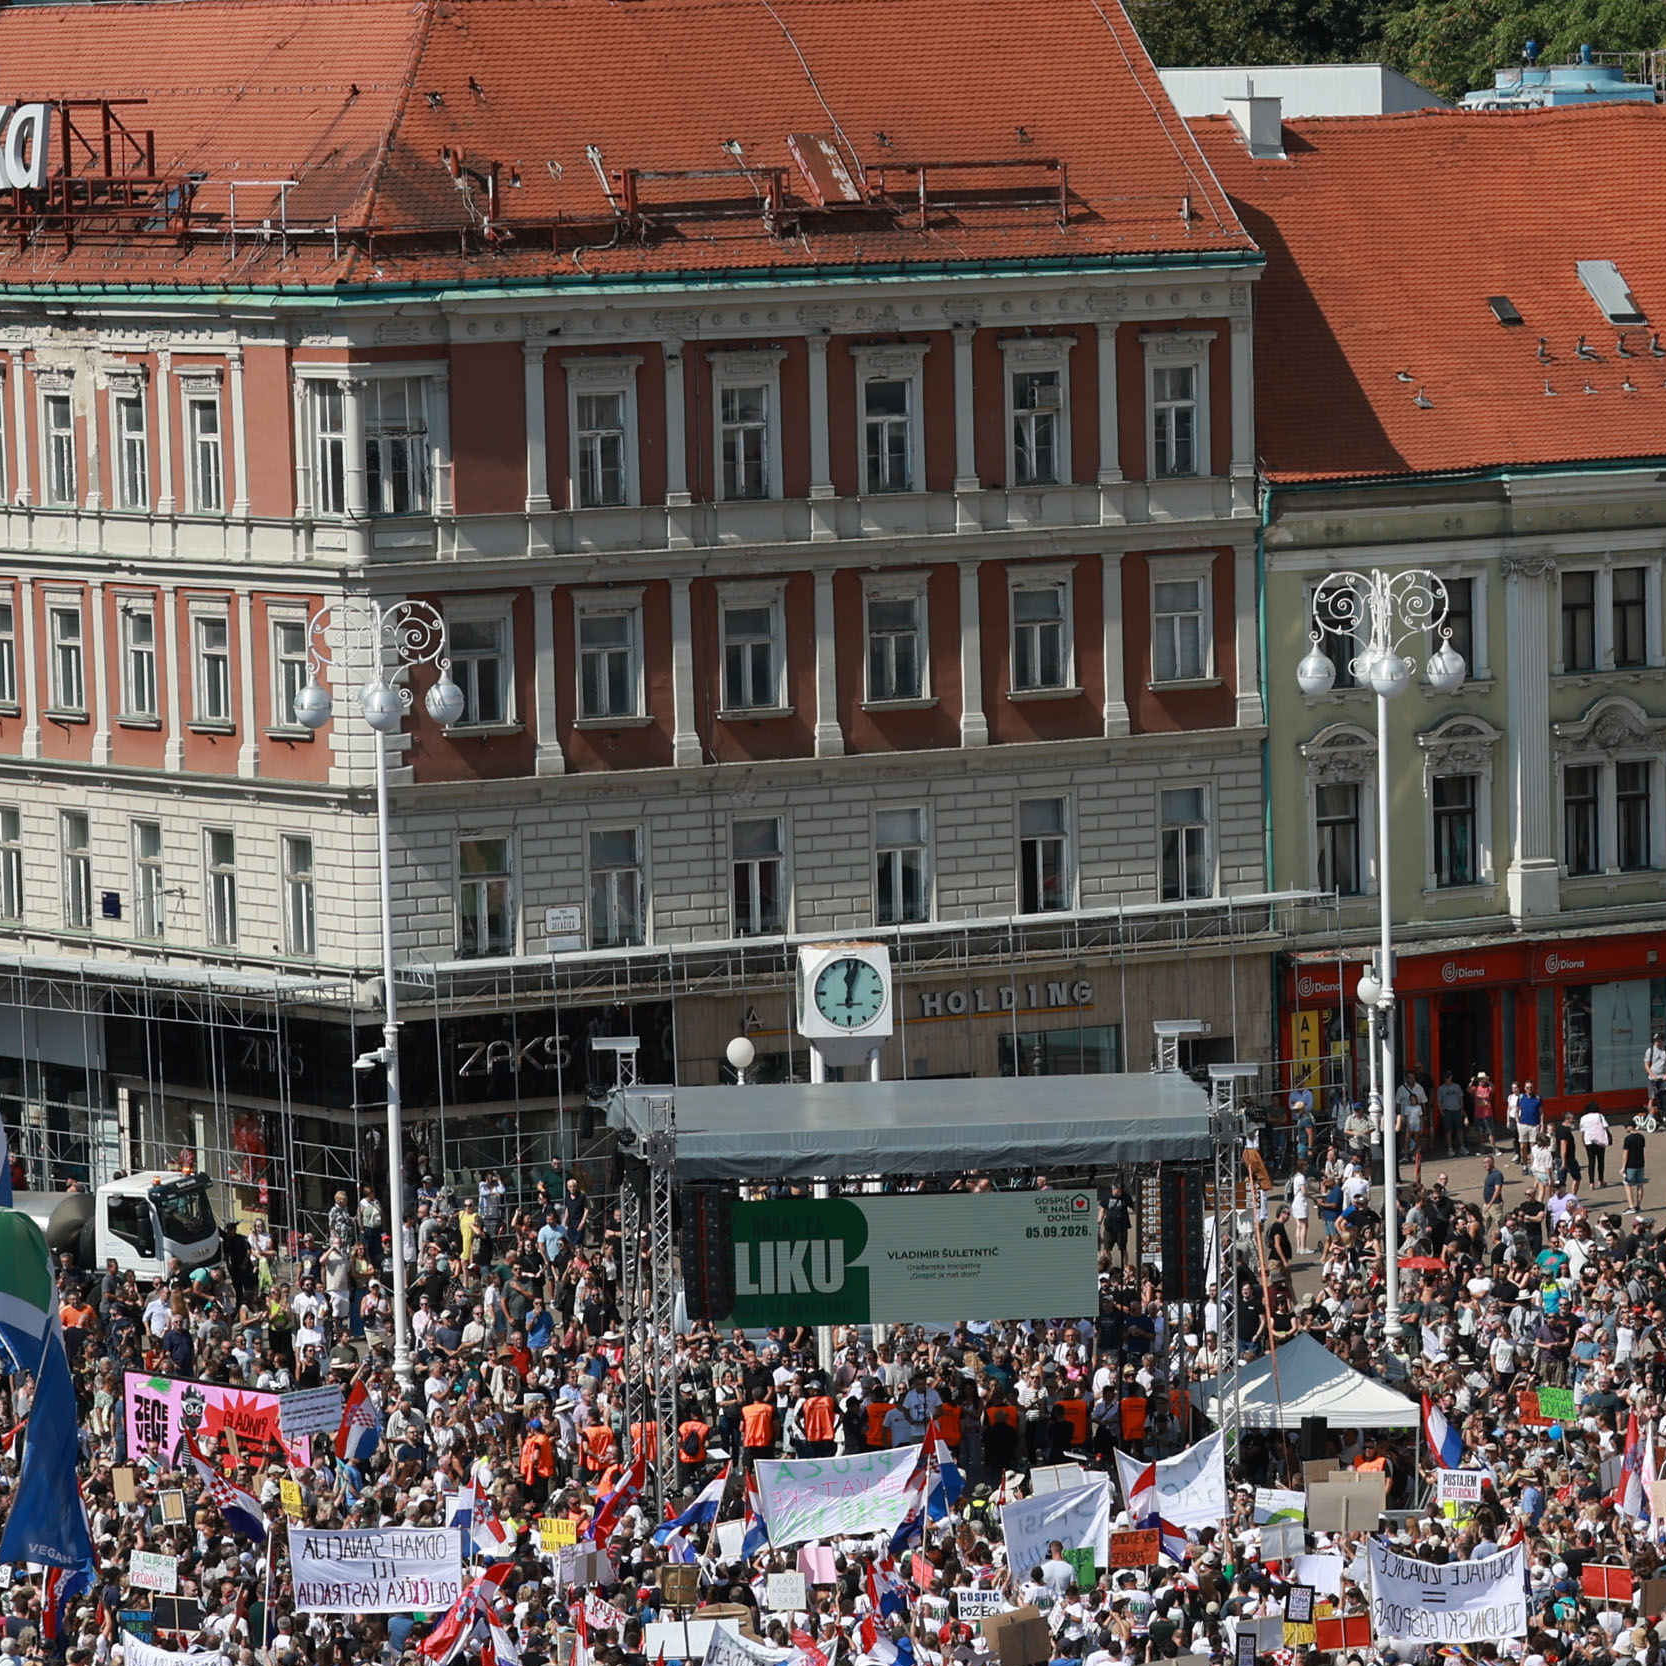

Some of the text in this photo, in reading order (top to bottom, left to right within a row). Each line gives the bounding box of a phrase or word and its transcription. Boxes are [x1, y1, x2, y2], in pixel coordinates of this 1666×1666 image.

[1560, 957, 1585, 971] Diona
[1458, 965, 1486, 979] Diona
[921, 979, 1094, 1017] HOLDING
[457, 1035, 571, 1078] ZAKS
[1034, 1195, 1070, 1207] GOSPIĆ
[1037, 1204, 1070, 1215] JE NAŠ
[1047, 1214, 1070, 1223] DOM
[1025, 1226, 1092, 1239] 05.09.2026.
[887, 1246, 999, 1261] VLADIMIR ŠULETNTIĆ
[734, 1238, 845, 1296] LIKU
[906, 1261, 981, 1273] Građanska inicijativa
[1541, 1400, 1574, 1415] ODMAH
[223, 1410, 268, 1436] GLADNI?
[1443, 1473, 1477, 1487] POSTAJEM
[1442, 1486, 1477, 1499] HISTERIČNA!
[557, 1521, 575, 1536] LIKO
[28, 1543, 72, 1564] VEGAN
